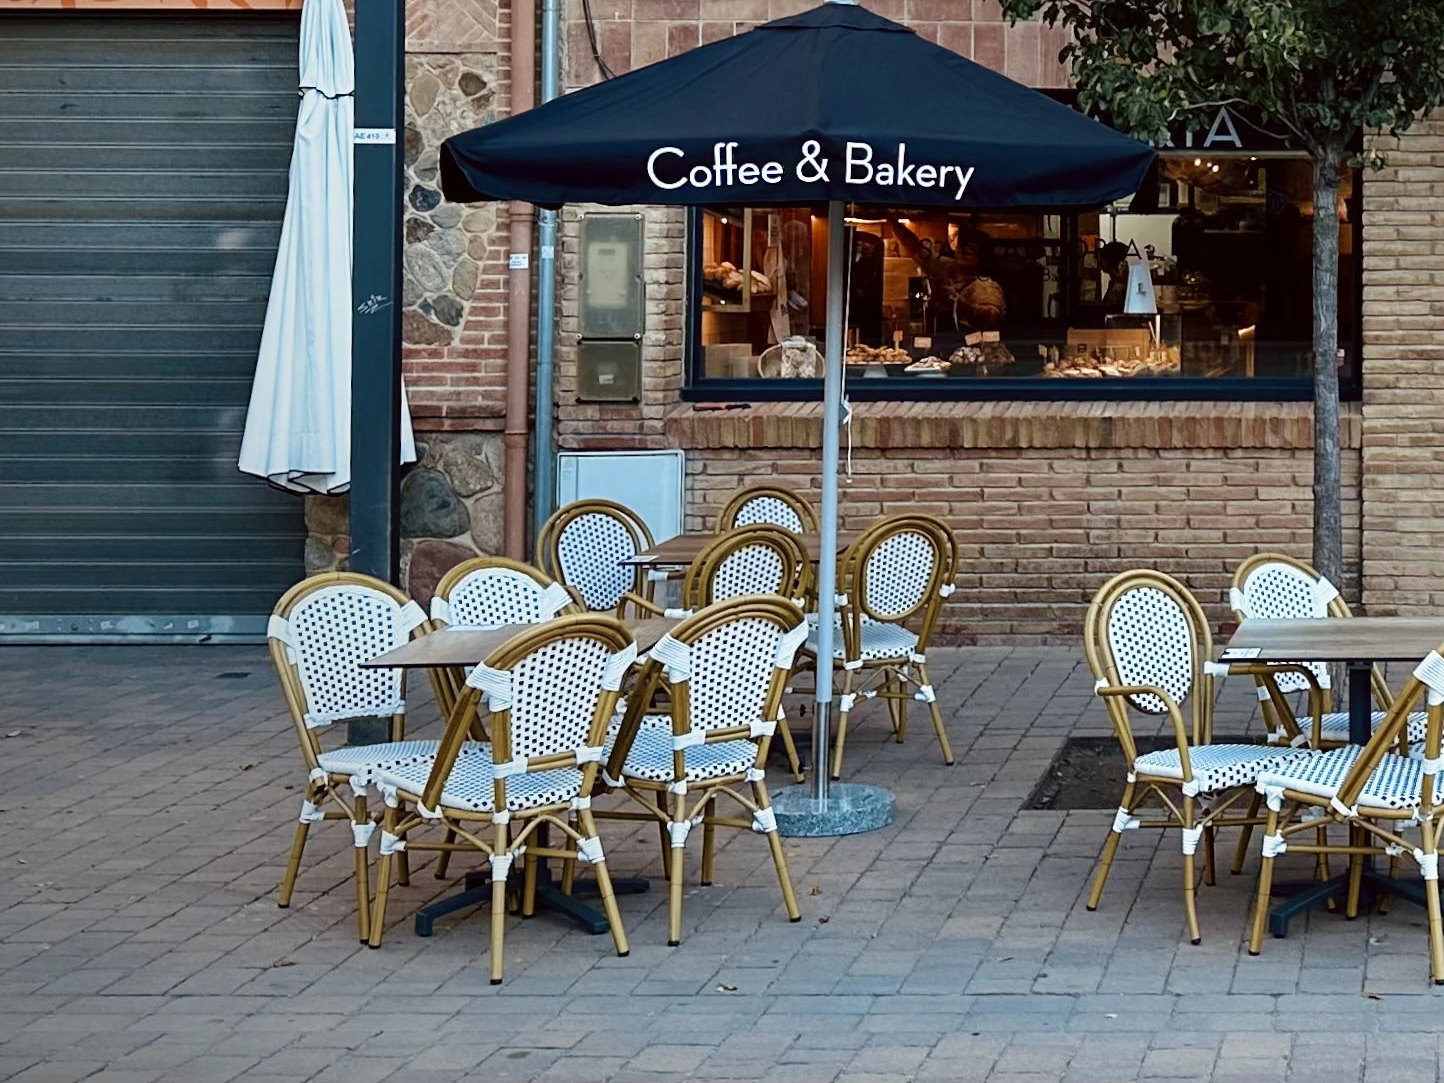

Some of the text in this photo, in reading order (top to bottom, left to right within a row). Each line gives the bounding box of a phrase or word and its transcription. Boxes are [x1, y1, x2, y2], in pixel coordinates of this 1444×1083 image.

[647, 139, 975, 201] Coffee & Bakery
